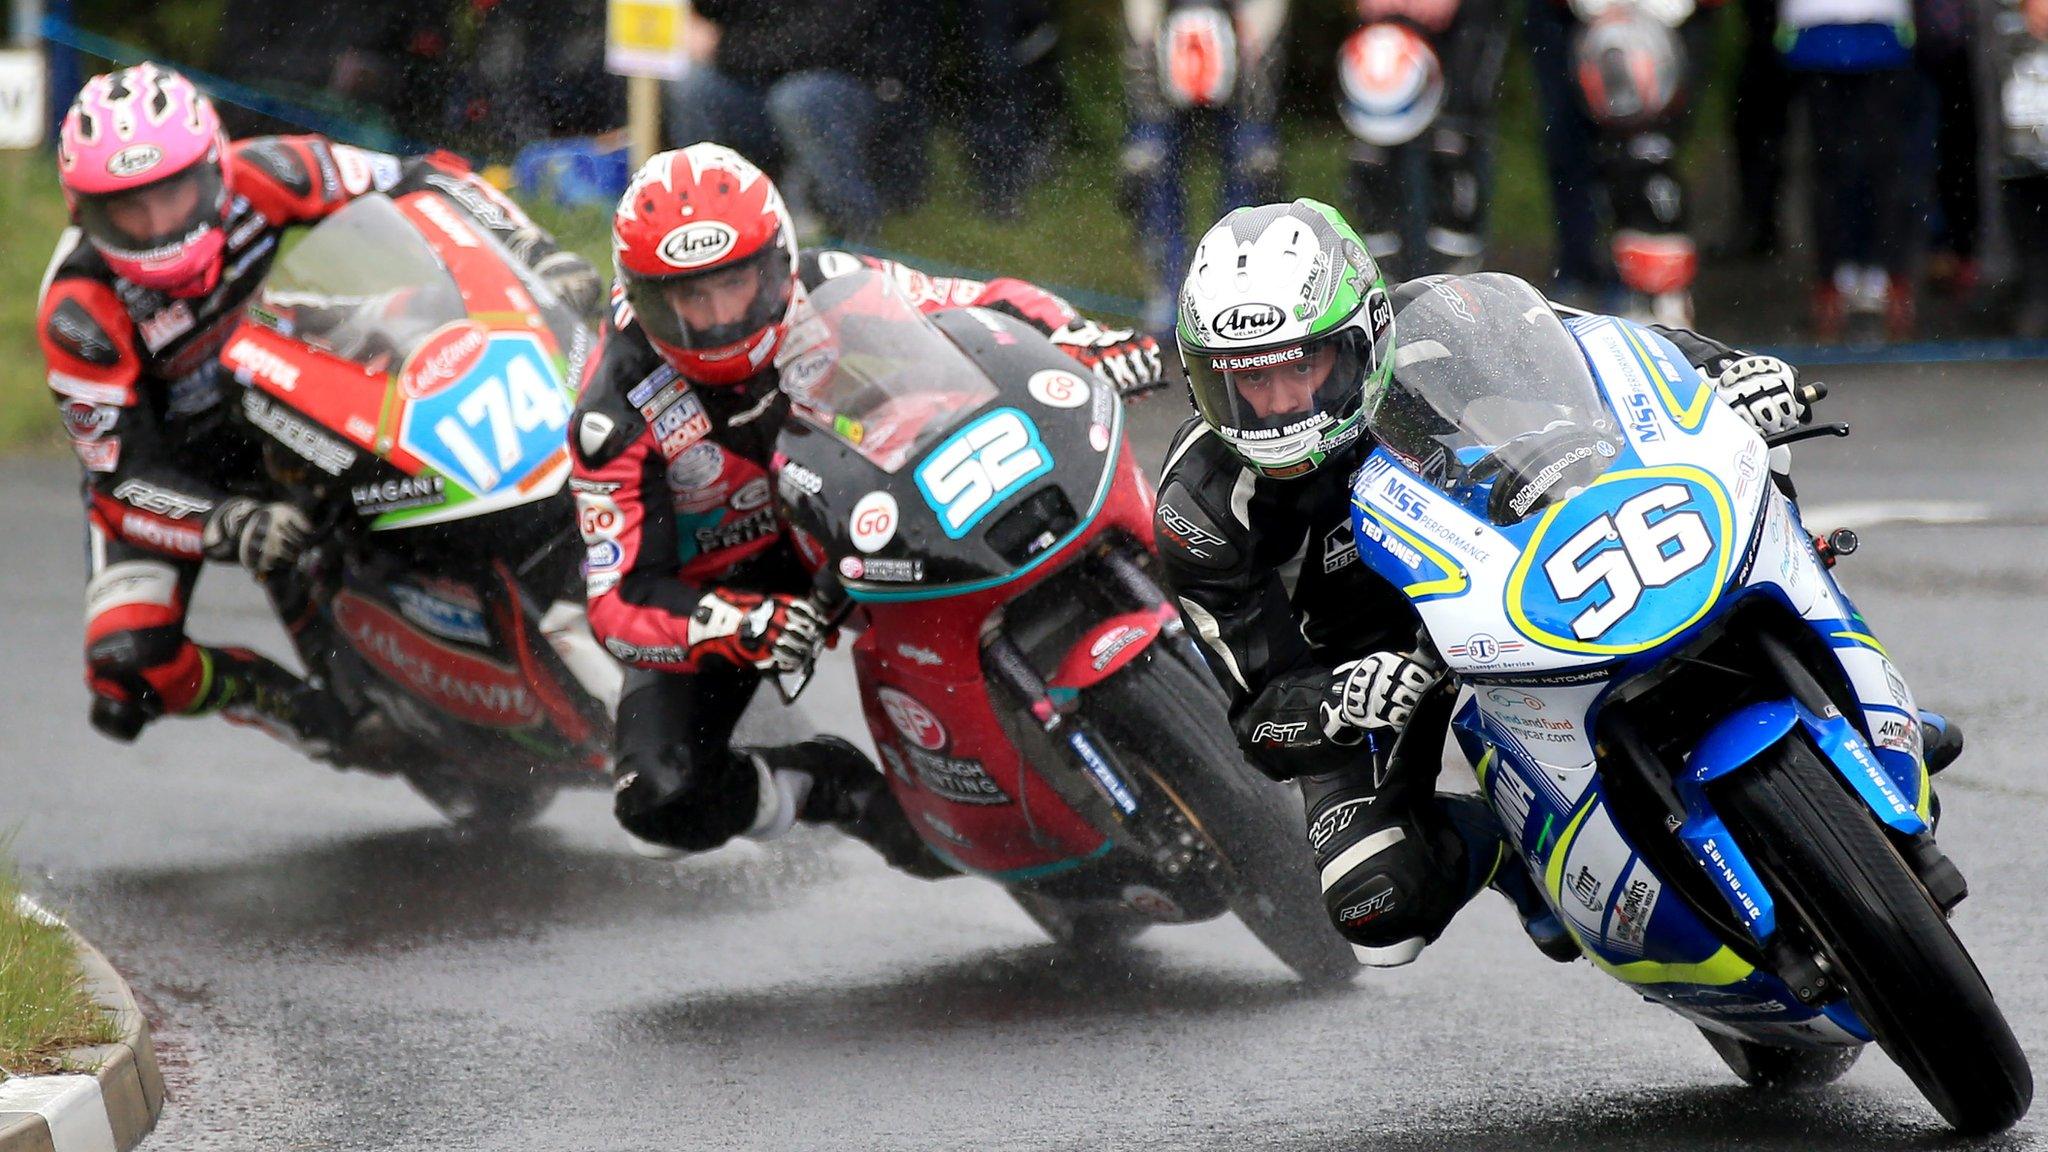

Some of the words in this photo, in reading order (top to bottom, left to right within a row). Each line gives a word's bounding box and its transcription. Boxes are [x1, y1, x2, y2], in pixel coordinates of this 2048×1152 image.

[670, 228, 723, 254] Arai
[1222, 305, 1277, 332] Arai
[1234, 328, 1265, 337] HELMET
[1231, 347, 1304, 369] SUPERBIKES
[435, 354, 567, 492] 174
[1220, 425, 1239, 438] ROY
[1242, 428, 1280, 440] HANNA
[1283, 410, 1329, 436] MOTORS
[1629, 393, 1657, 443] MSS
[925, 411, 1044, 530] 52
[1522, 456, 1566, 499] Hamilton
[1569, 449, 1578, 462] &
[1577, 447, 1591, 459] Co
[112, 478, 212, 520] RST
[1518, 472, 1562, 516] Cookstown
[1158, 504, 1227, 546] RST
[1384, 476, 1427, 522] MSS
[1419, 515, 1490, 565] PERFORMANCE
[1361, 517, 1383, 543] TED
[1381, 534, 1422, 570] JONES
[1545, 483, 1713, 641] 56
[1541, 669, 1609, 684] HUTCHMAN
[1252, 721, 1308, 742] RST
[1072, 731, 1137, 814] METZELER
[1844, 740, 1907, 815] METZELER
[1702, 838, 1762, 920] METZELER
[1340, 887, 1394, 922] RST
